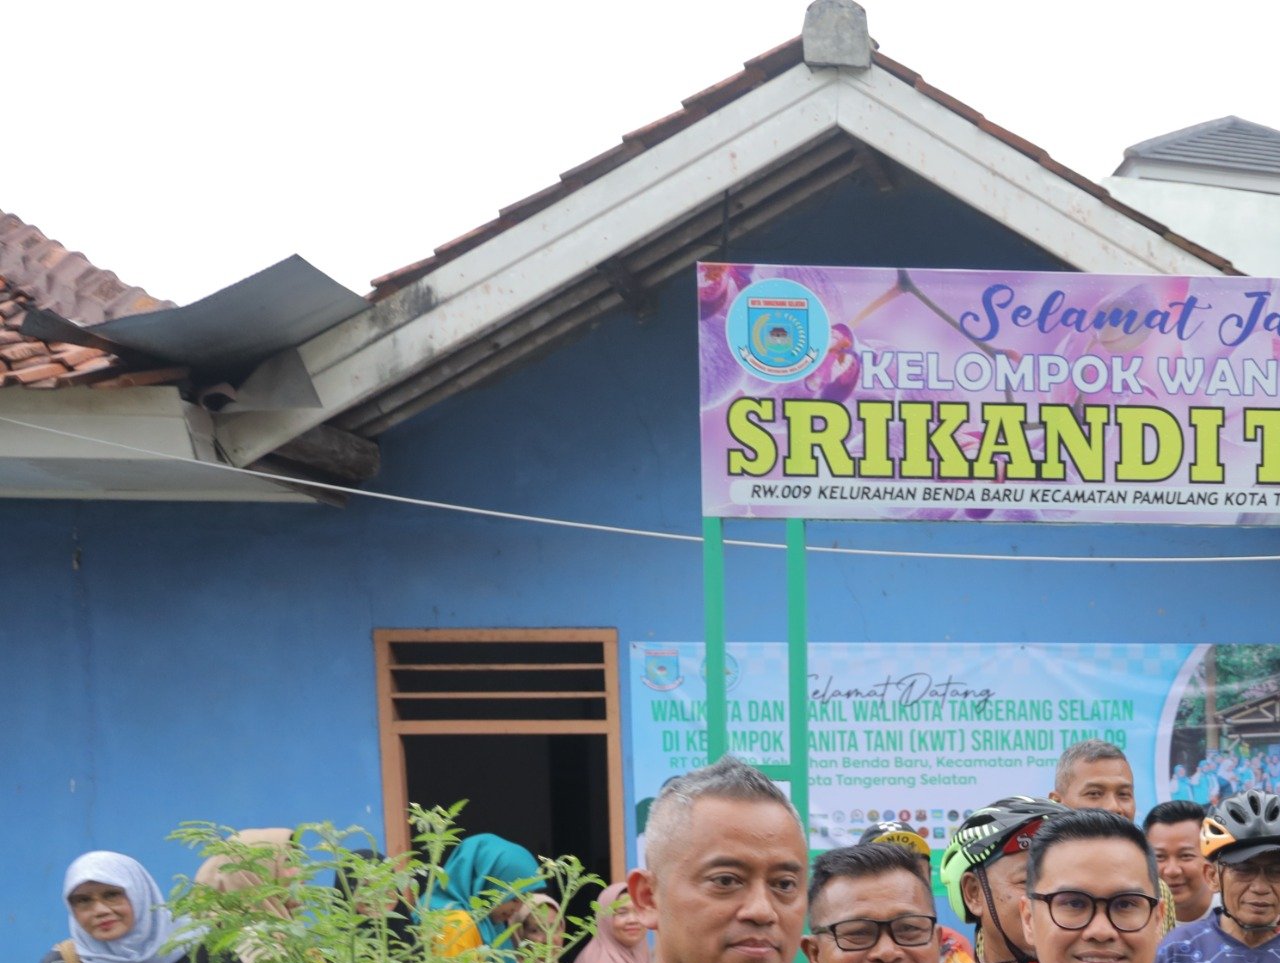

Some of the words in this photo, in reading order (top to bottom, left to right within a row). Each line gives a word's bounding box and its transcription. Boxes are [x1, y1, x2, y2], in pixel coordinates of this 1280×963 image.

[960, 284, 1212, 342] Selamat
[860, 350, 1144, 395] KELOMPOK
[726, 397, 1225, 483] SRIKANDI
[751, 485, 812, 499] RW.009
[818, 485, 916, 501] KELURAHAN
[922, 487, 975, 501] BENDA
[980, 488, 1025, 502] BARU
[1030, 489, 1128, 504] KECAMATAN
[1132, 491, 1219, 506] PAMULANG
[1224, 492, 1268, 506] KOTA
[808, 673, 904, 709] elamat
[897, 672, 995, 715] Datang
[651, 699, 742, 722] WALIKA
[748, 699, 785, 722] DAN
[808, 699, 847, 722] AKIL
[852, 699, 944, 722] WALIKOTA
[948, 698, 1053, 722] TANGERANG
[1058, 698, 1134, 722] SELATAN
[662, 729, 680, 752] DI
[686, 729, 785, 752] KEMPOK
[808, 729, 859, 752] ANITA
[864, 729, 904, 752] TANI
[910, 728, 965, 753] (KWT)
[971, 729, 1054, 752] SRIKANDI
[670, 756, 687, 768] RT
[842, 757, 890, 768] Benda
[894, 757, 932, 770] Baru,
[936, 757, 1023, 768] Kecamatan
[808, 775, 832, 786] ota
[836, 774, 916, 788] Tangerang
[920, 774, 977, 785] Selatan
